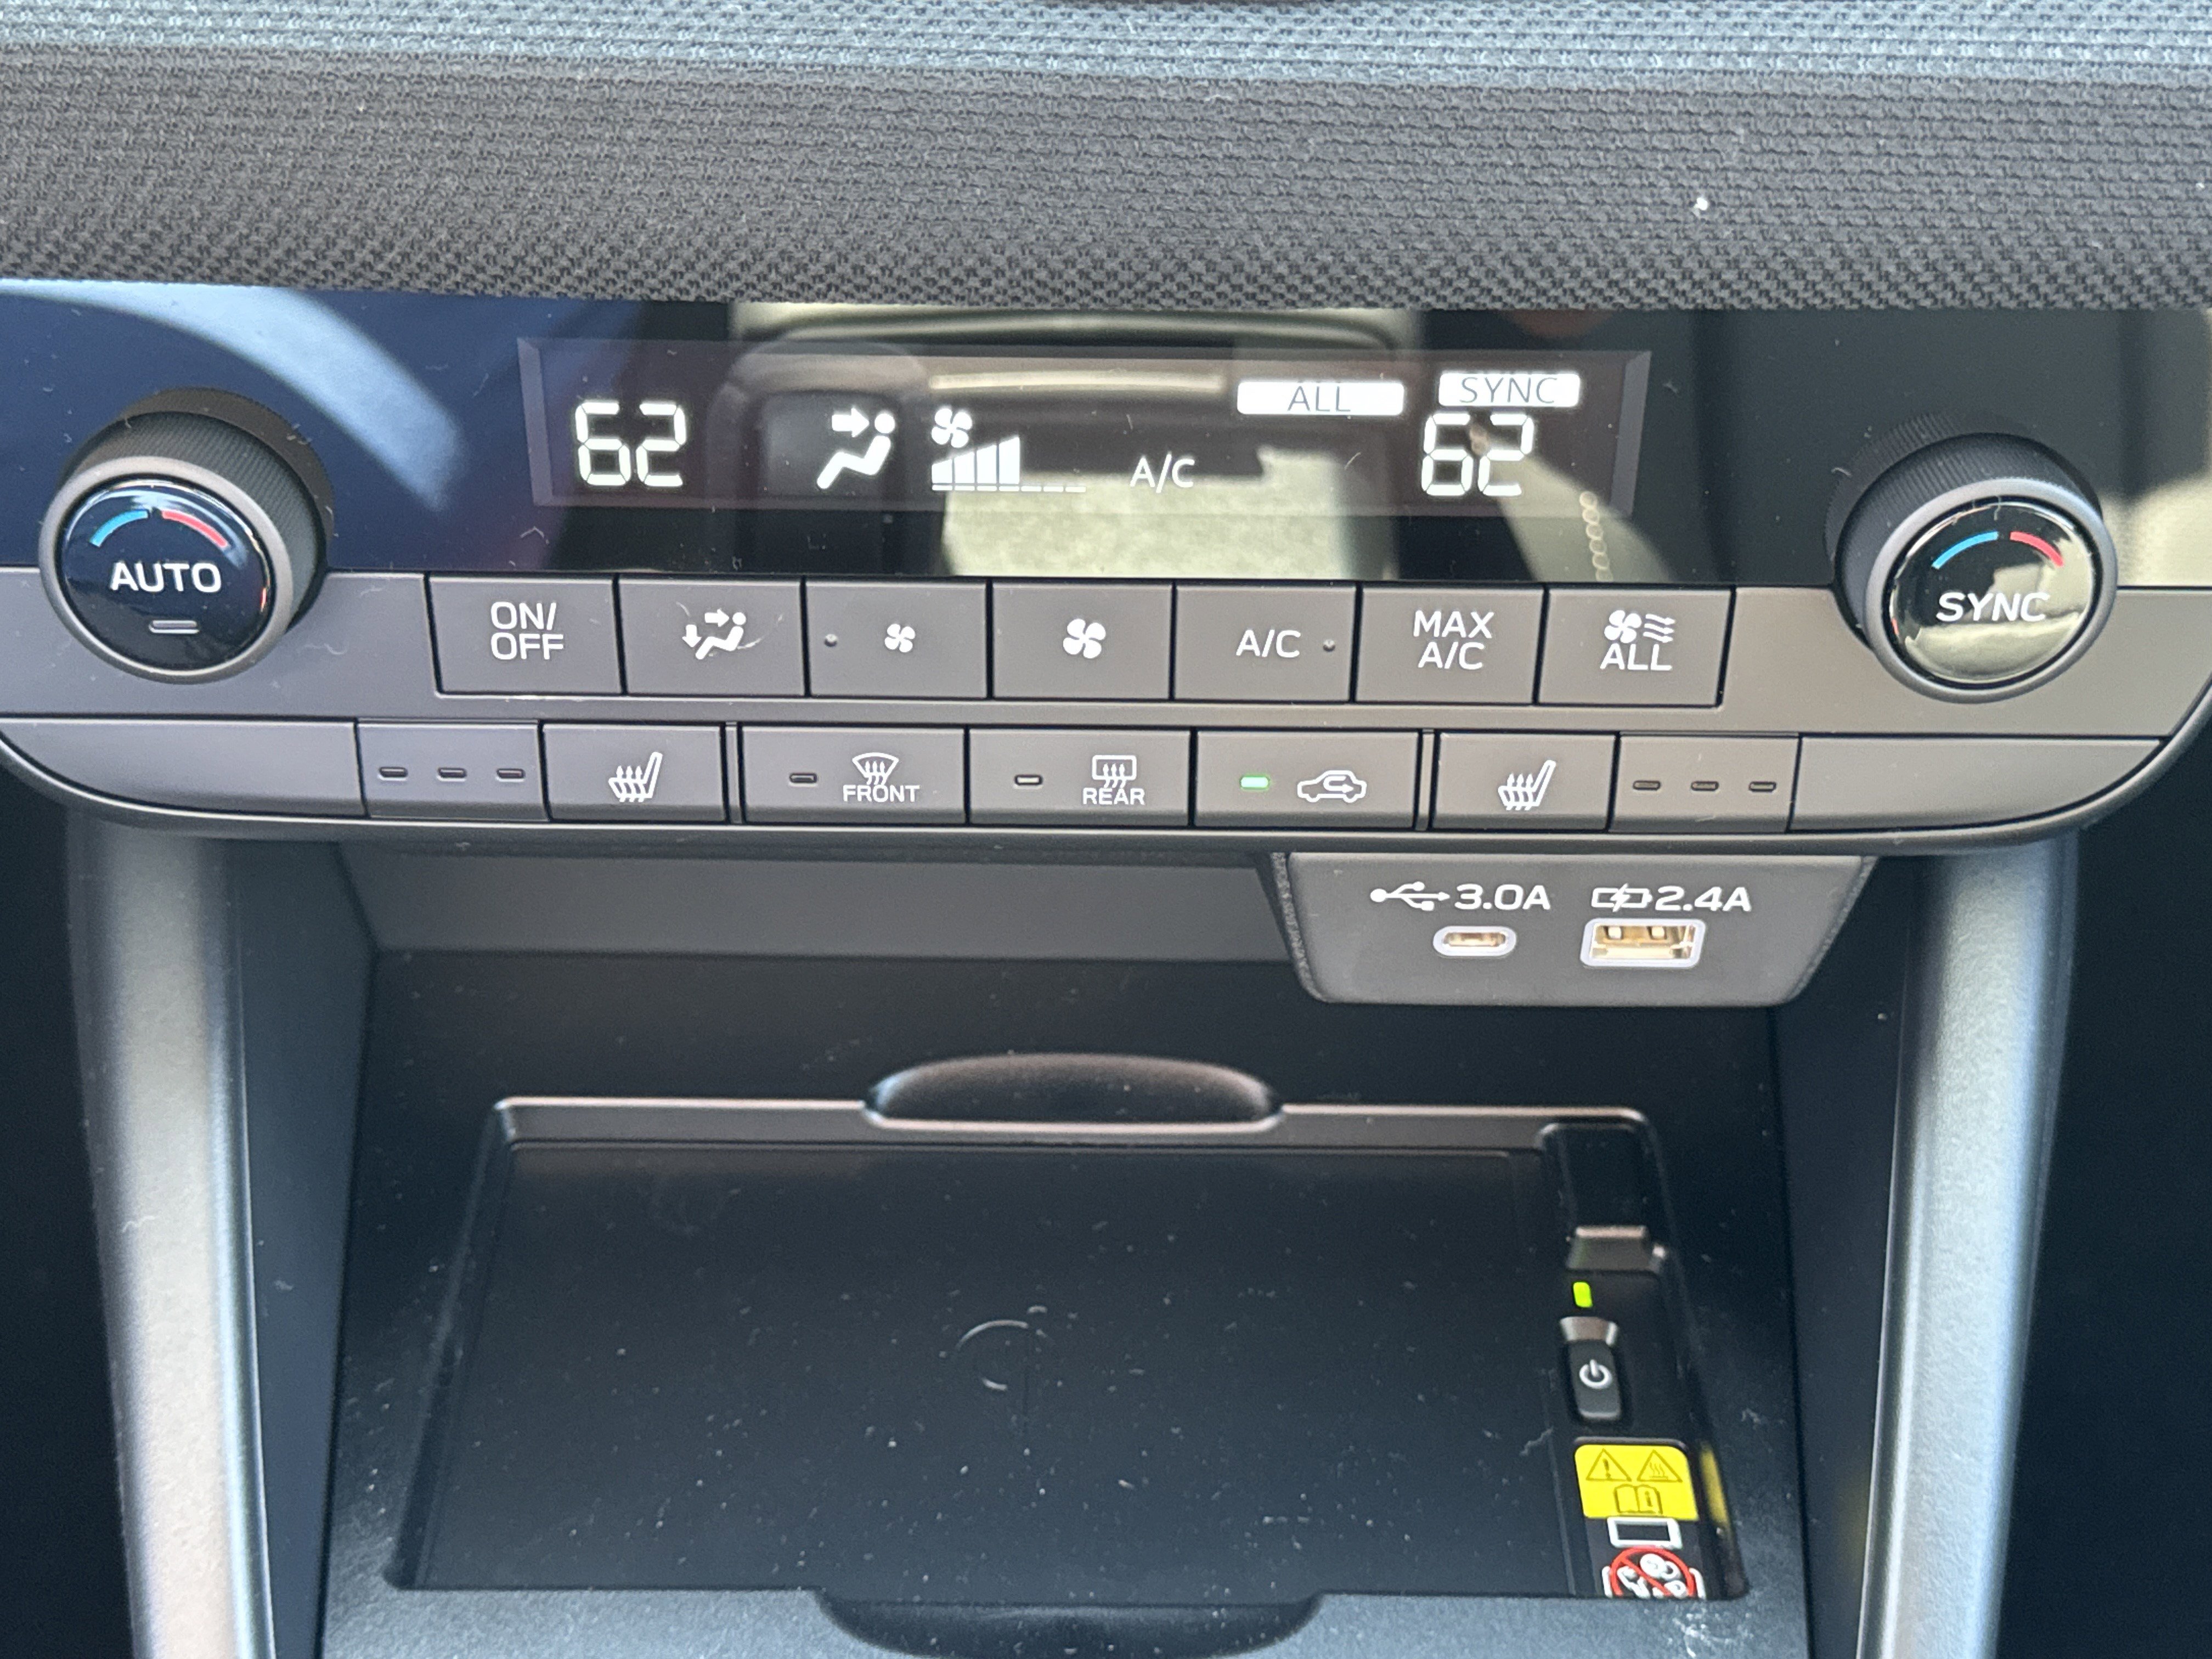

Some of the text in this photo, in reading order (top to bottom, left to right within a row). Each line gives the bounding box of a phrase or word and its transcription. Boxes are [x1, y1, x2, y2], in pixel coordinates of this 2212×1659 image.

[1286, 386, 1351, 412] ALL
[1459, 376, 1558, 404] SYNC
[575, 402, 687, 487] 62
[1421, 411, 1535, 496] 62
[1129, 452, 1195, 494] A/C
[110, 561, 222, 593] AUTO
[490, 601, 557, 630] ON/
[1936, 592, 2051, 623] SYNC
[1413, 610, 1495, 639] MAX
[490, 632, 564, 660] OFF
[1235, 629, 1301, 658] A/C
[1417, 641, 1485, 670] A/C
[1599, 643, 1672, 672] ALL
[842, 784, 920, 803] FRONT
[1082, 787, 1146, 806] REAR
[1454, 883, 1551, 911] 3.0A
[1654, 885, 1752, 913] 2.4A
